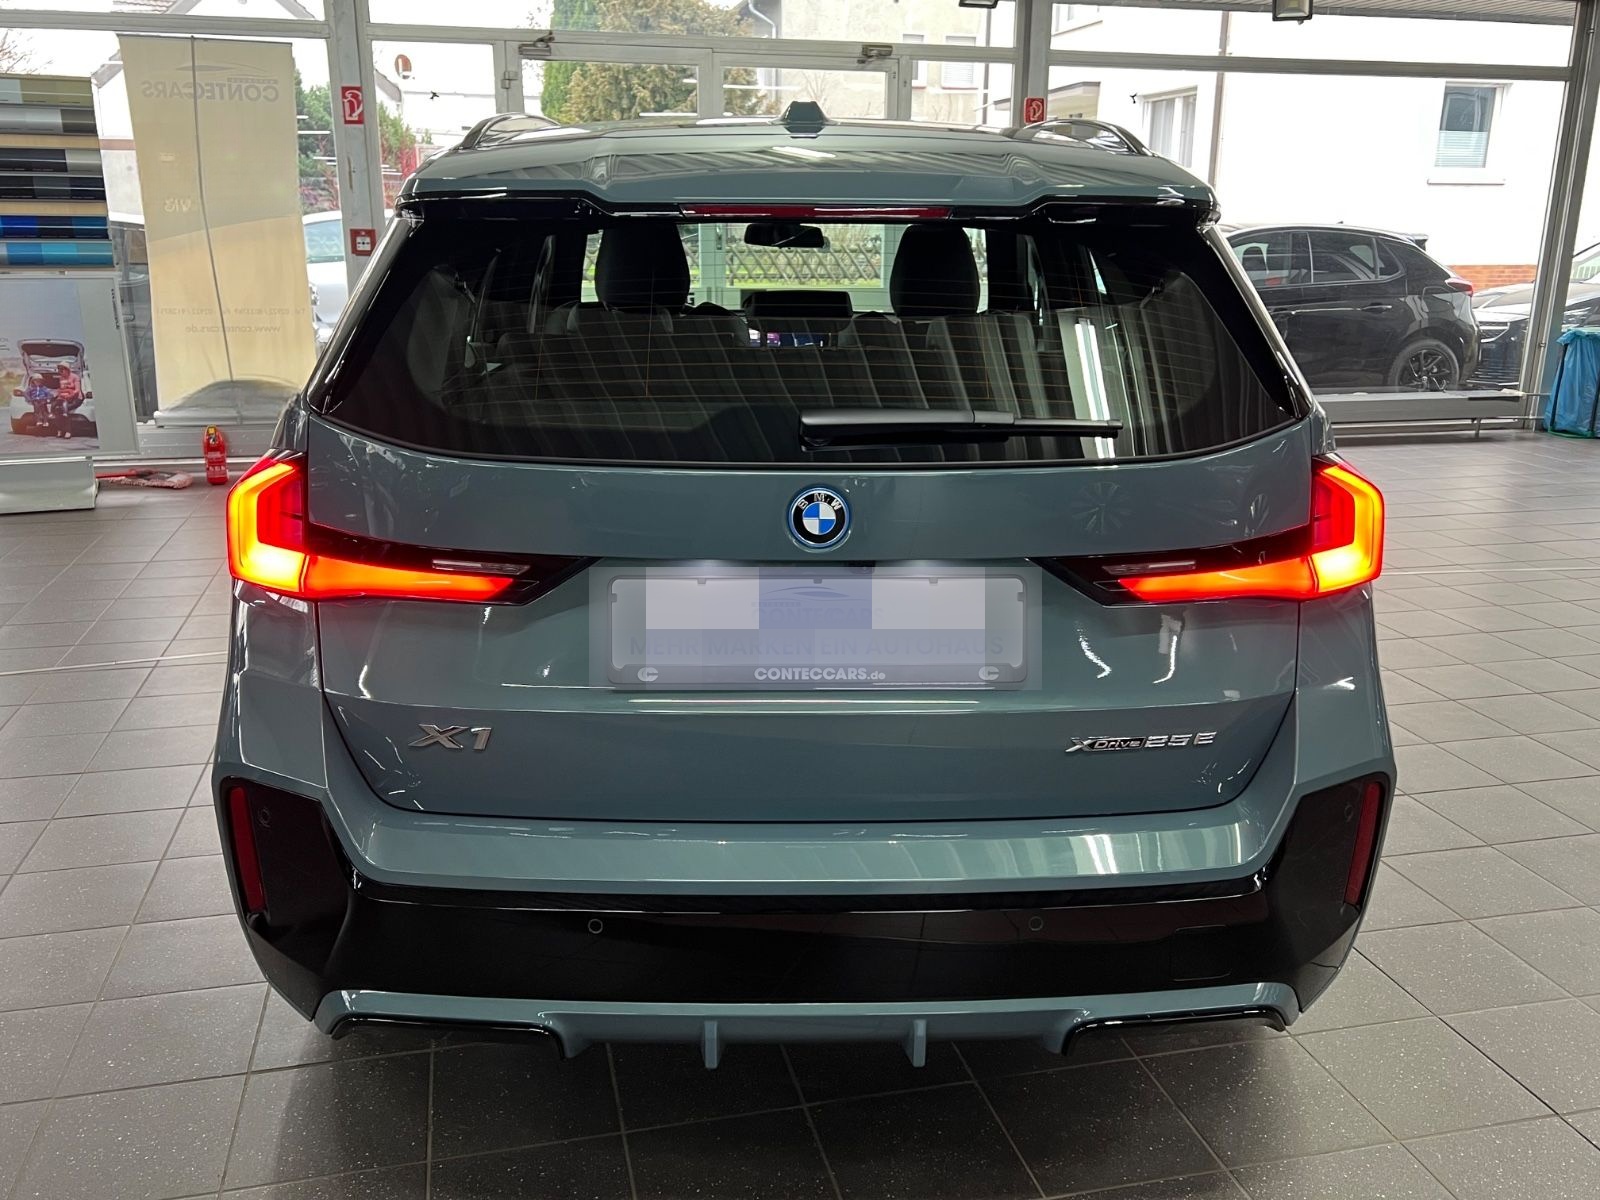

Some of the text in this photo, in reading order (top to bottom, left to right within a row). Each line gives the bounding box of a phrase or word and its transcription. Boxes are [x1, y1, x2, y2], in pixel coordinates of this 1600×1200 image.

[798, 493, 842, 511] BMW
[630, 636, 1004, 655] MEHR MARKEN EIN AUTOHAUS
[754, 667, 886, 681] CONTECCARS.de
[408, 723, 493, 751] X1
